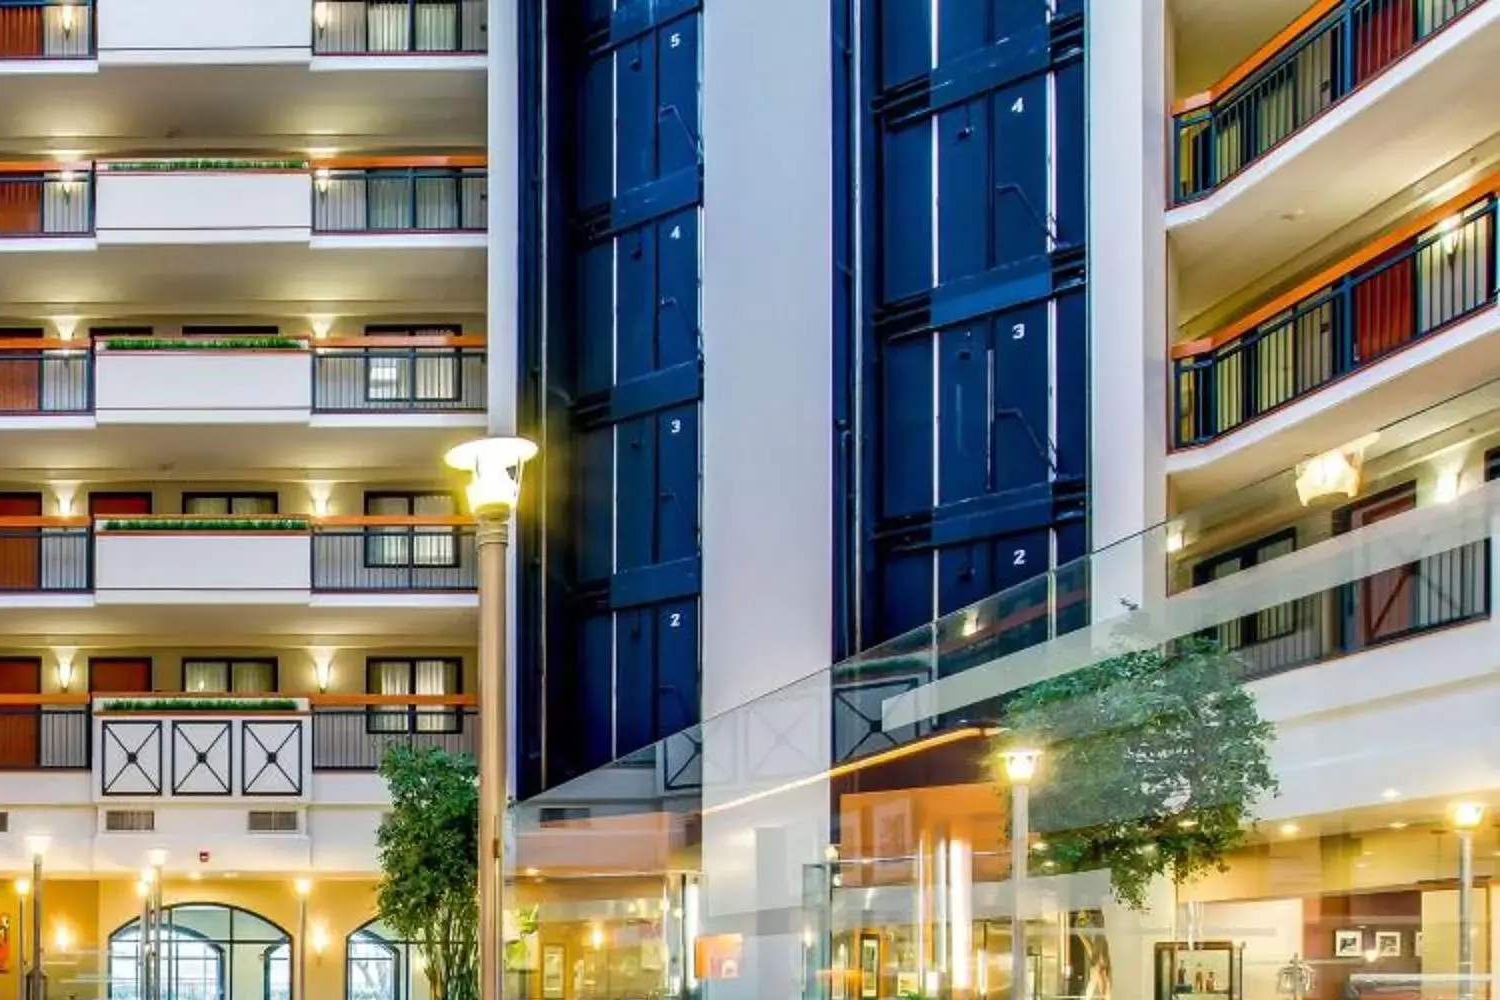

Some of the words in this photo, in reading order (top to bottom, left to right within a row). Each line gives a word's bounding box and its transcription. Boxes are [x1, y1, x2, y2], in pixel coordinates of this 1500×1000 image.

[671, 33, 681, 48] 5
[1011, 97, 1024, 114] 4
[671, 225, 680, 240] 4
[1013, 323, 1025, 339] 3
[671, 419, 681, 434] 3
[1013, 549, 1026, 565] 2
[670, 613, 681, 627] 2
